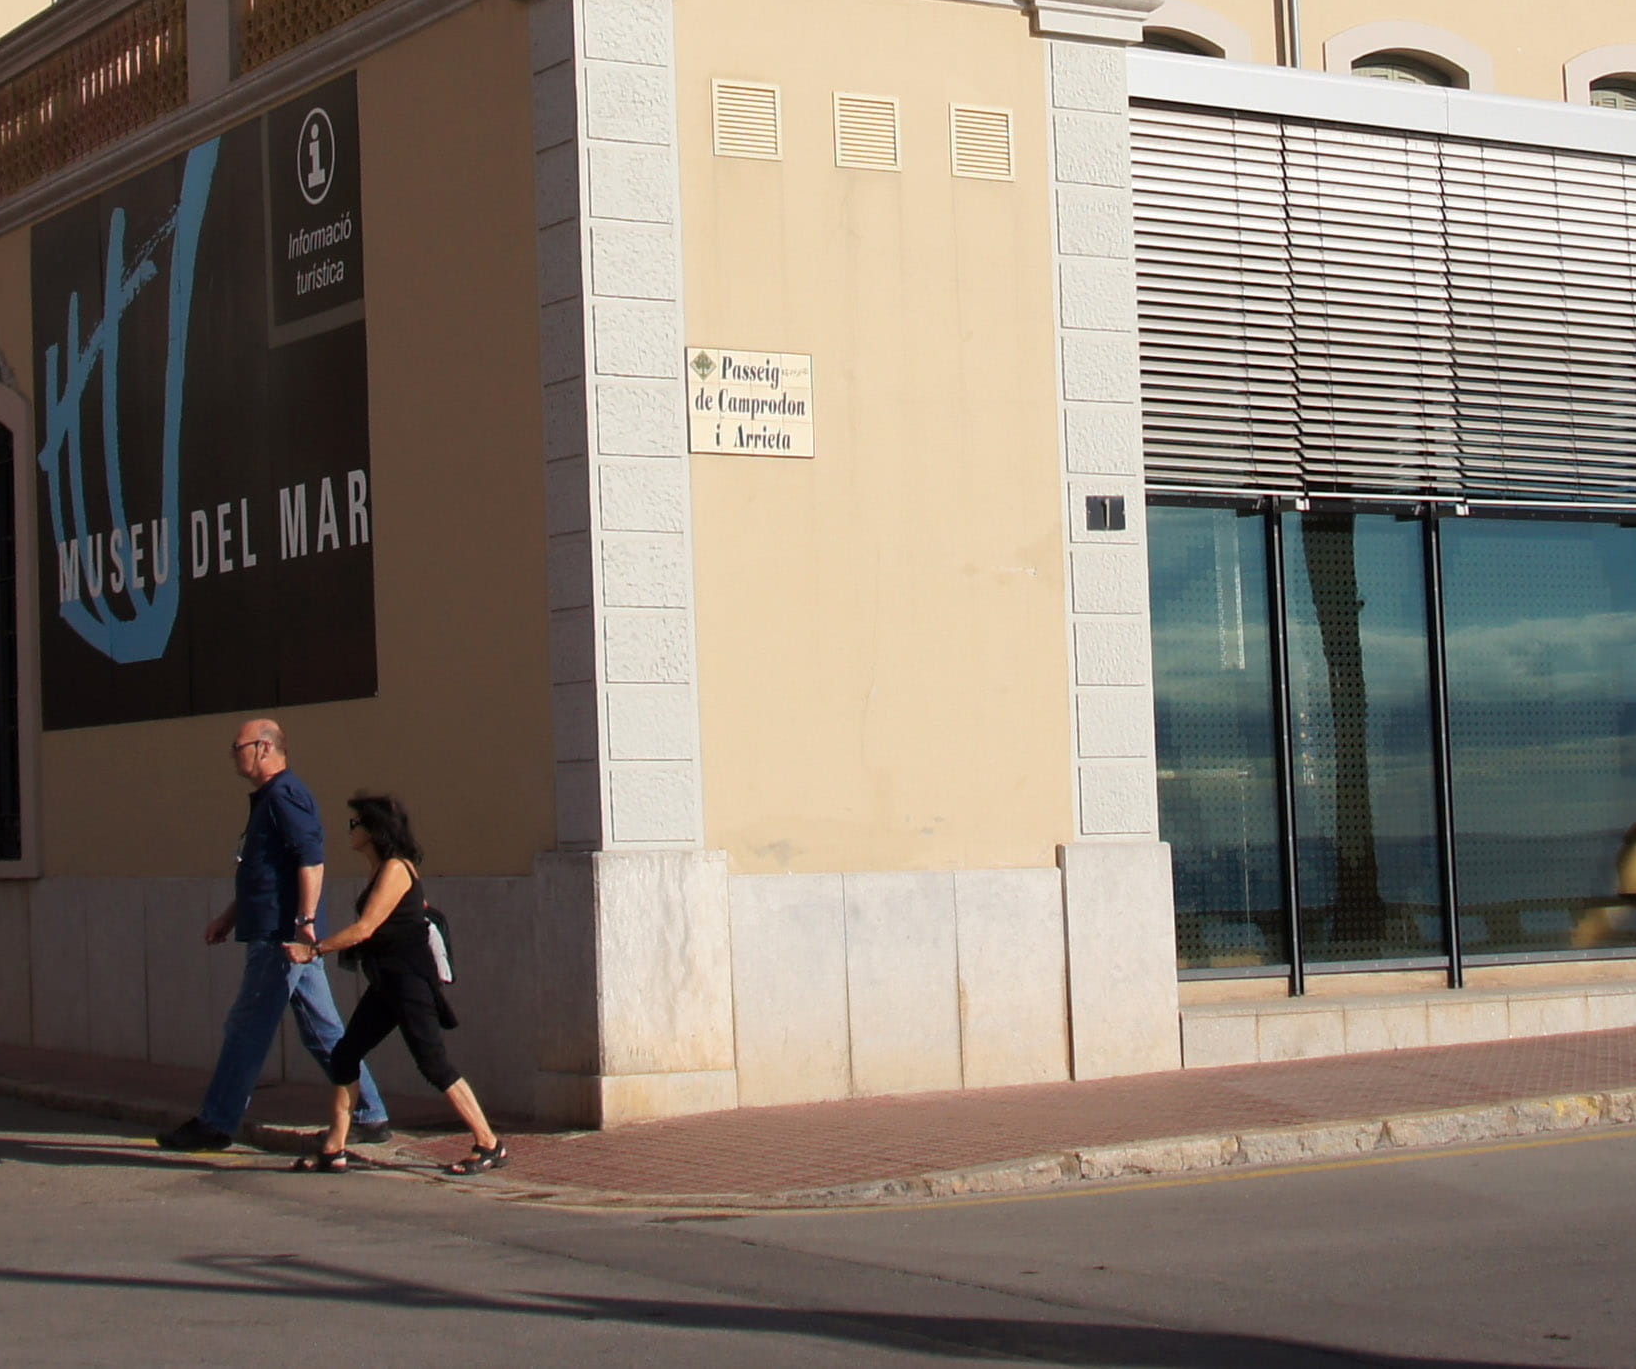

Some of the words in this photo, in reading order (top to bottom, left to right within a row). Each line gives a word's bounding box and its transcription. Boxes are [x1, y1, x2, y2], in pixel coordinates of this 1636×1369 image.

[287, 210, 352, 260] Informació
[296, 258, 345, 296] turística
[721, 356, 780, 390] Passeig
[695, 387, 713, 411] de
[718, 388, 806, 421] Camprodon
[715, 423, 721, 447] i
[733, 424, 791, 450] Arrieta
[58, 517, 169, 604] MUSEU
[190, 497, 257, 580] DEL
[278, 469, 370, 561] MAR
